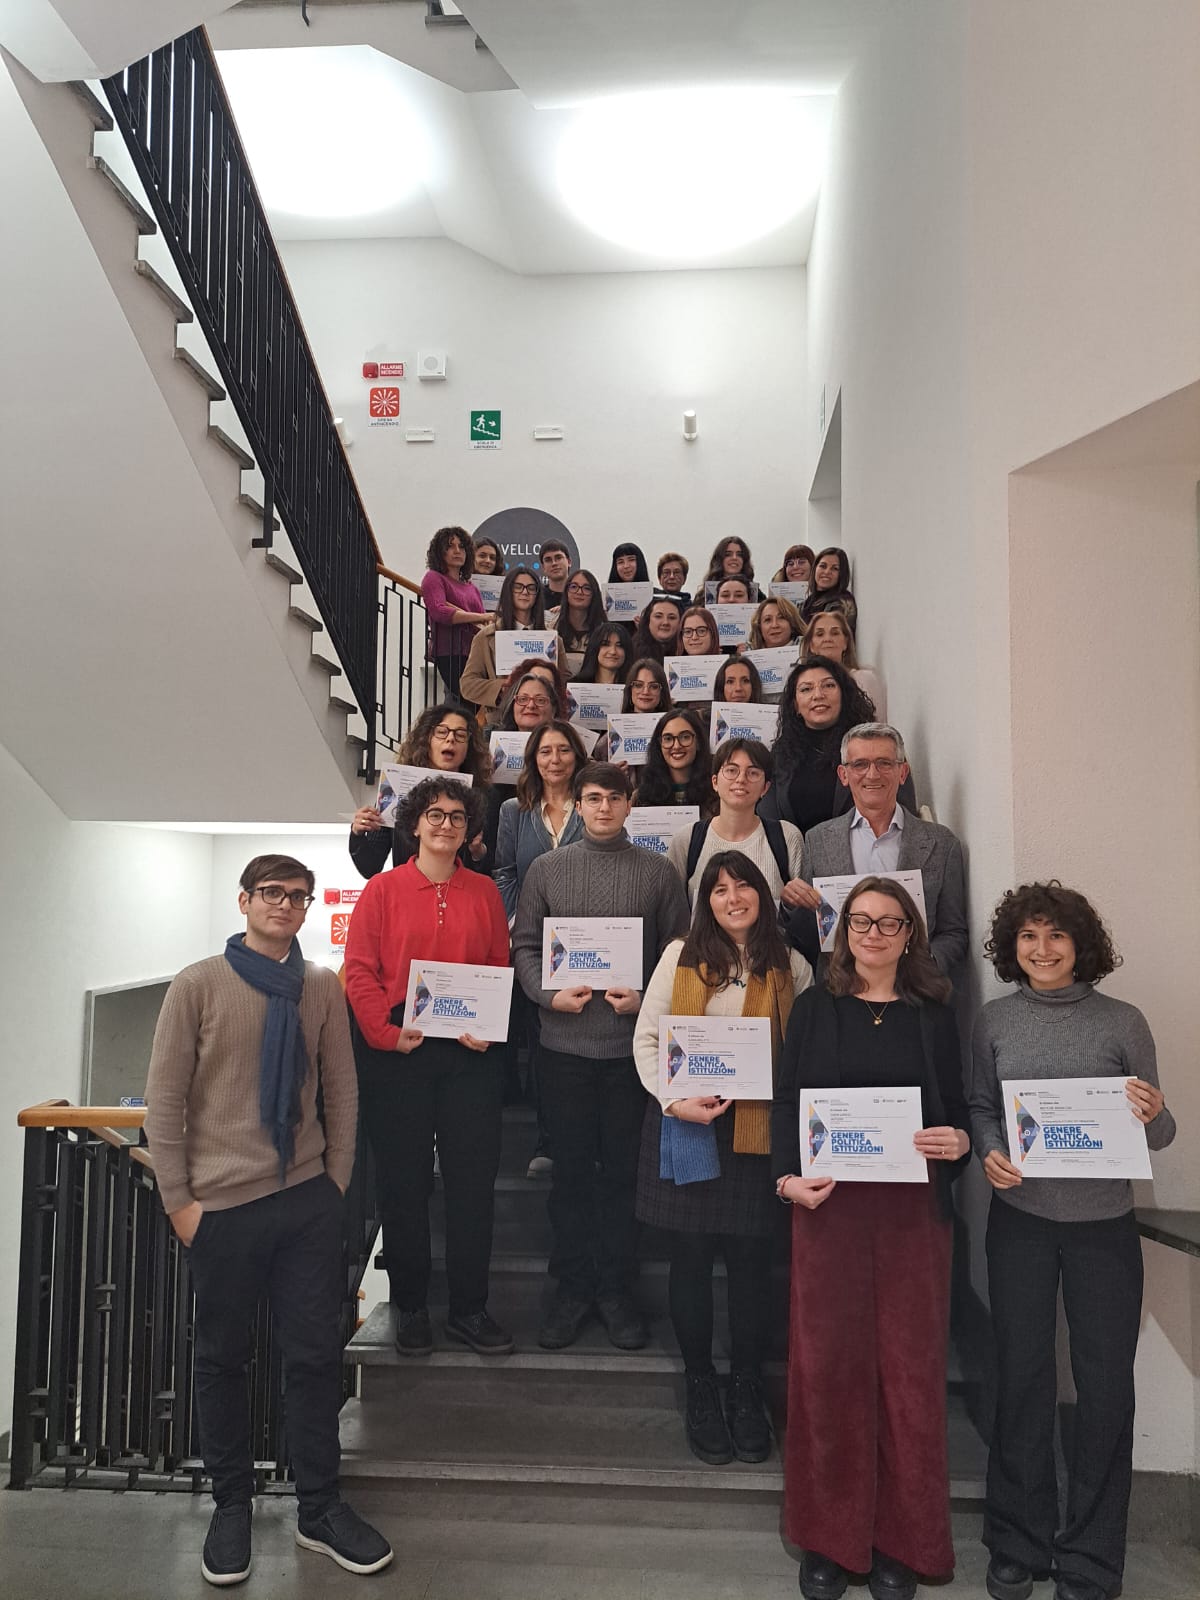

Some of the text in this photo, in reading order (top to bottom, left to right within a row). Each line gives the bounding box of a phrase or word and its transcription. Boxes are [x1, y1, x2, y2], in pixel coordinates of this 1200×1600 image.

[434, 998, 463, 1007] GENERE
[432, 1008, 477, 1017] ISTITUZIONI
[1043, 1126, 1082, 1134] GENERE
[830, 1132, 865, 1140] GENERE
[1044, 1133, 1090, 1141] POLITICA
[831, 1138, 872, 1146] POLITICA
[1045, 1140, 1103, 1148] ISTITUZIONI
[831, 1145, 884, 1153] ISTITUZIONI
